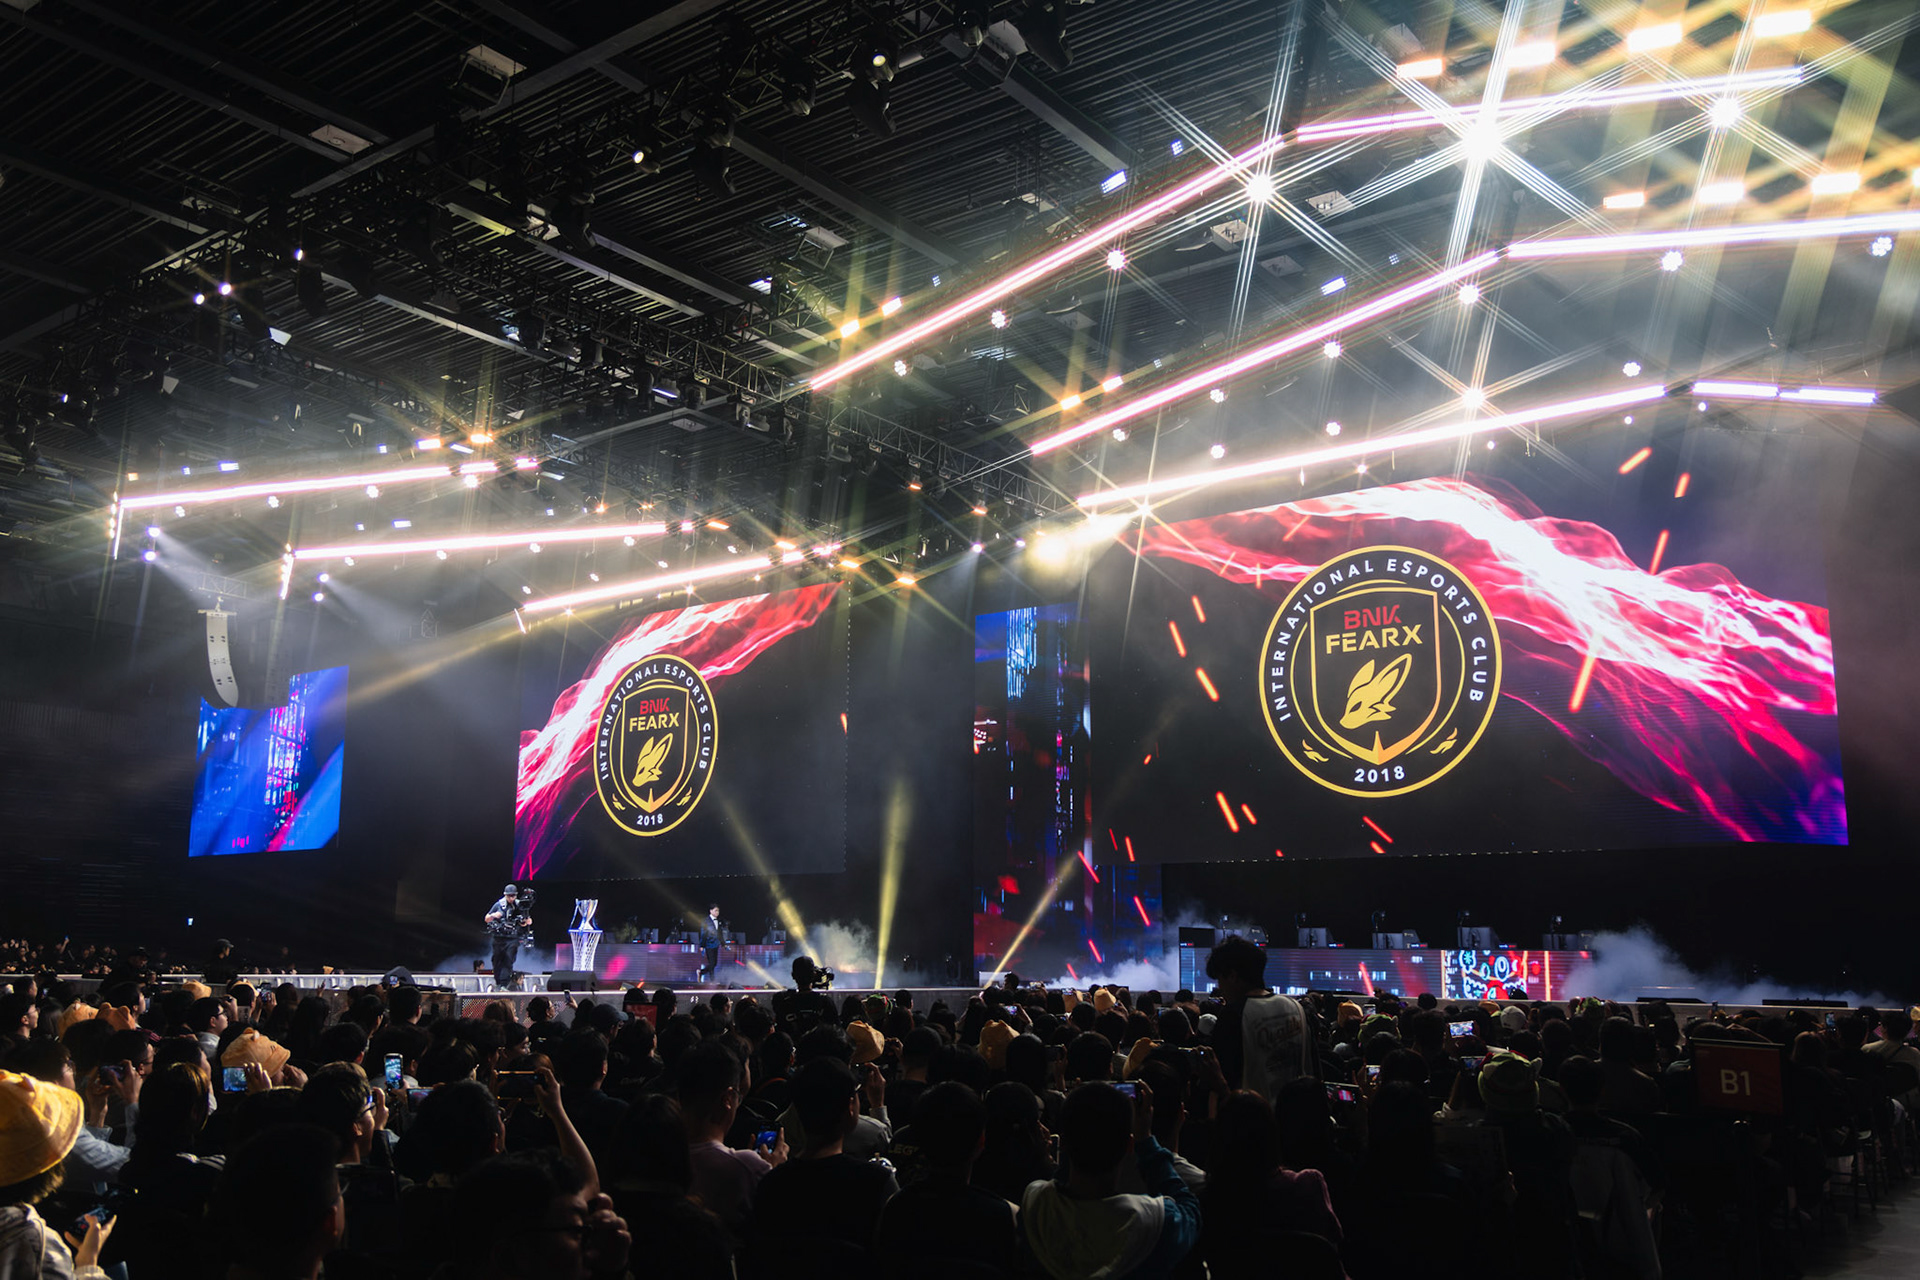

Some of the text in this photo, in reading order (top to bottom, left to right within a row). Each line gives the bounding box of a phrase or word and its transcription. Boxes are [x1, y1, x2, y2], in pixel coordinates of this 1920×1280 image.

[1343, 604, 1402, 630] BNK
[1271, 558, 1488, 722] INTERNATIONAL ESPORTS CLUB
[1325, 623, 1423, 655] FEARX
[639, 697, 671, 716] BNK
[600, 663, 711, 780] INTERNATIONAL ESPORTS CLUB
[628, 712, 680, 732] FEARX
[1354, 765, 1406, 783] 2018
[636, 813, 664, 826] 2018
[1719, 1068, 1752, 1097] B1
